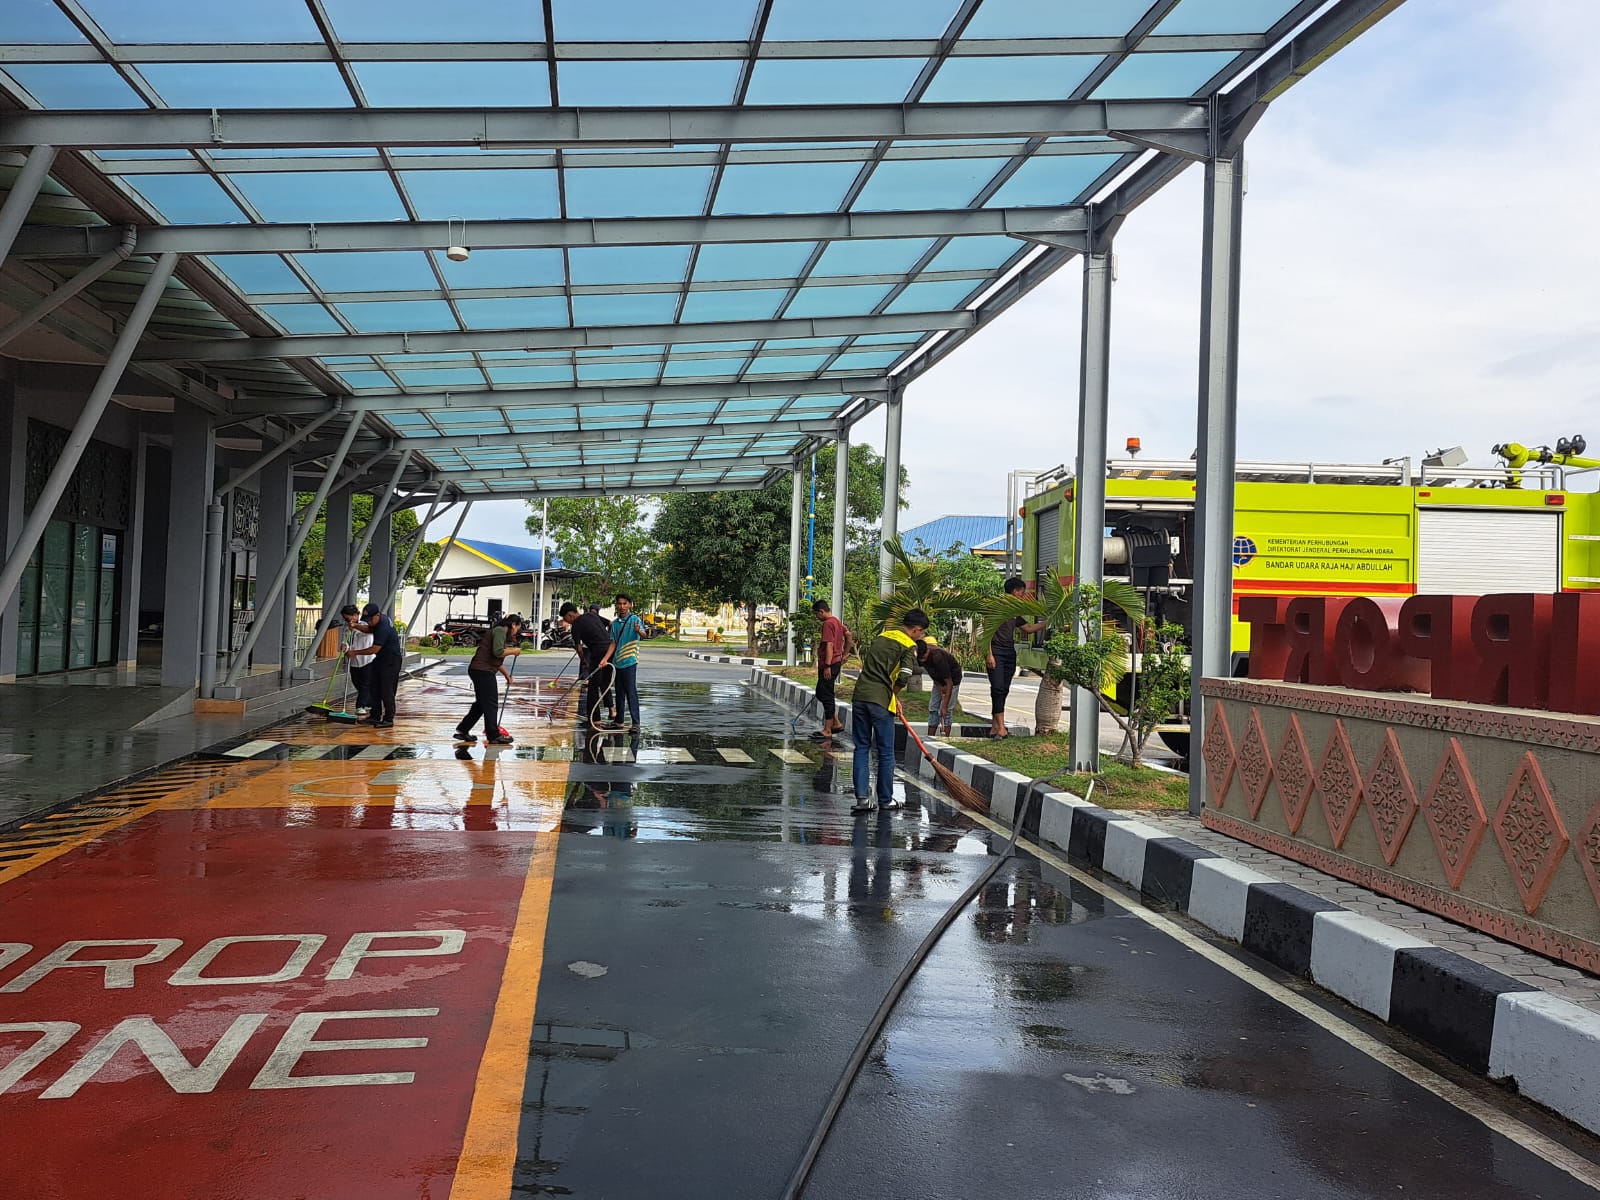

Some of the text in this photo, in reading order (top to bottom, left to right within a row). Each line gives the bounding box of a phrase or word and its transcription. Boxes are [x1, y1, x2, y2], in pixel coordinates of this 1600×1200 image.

[1265, 561, 1393, 572] BANDAR UDARA RAJA HAJI ABDULLAH
[0, 930, 465, 993] ROP
